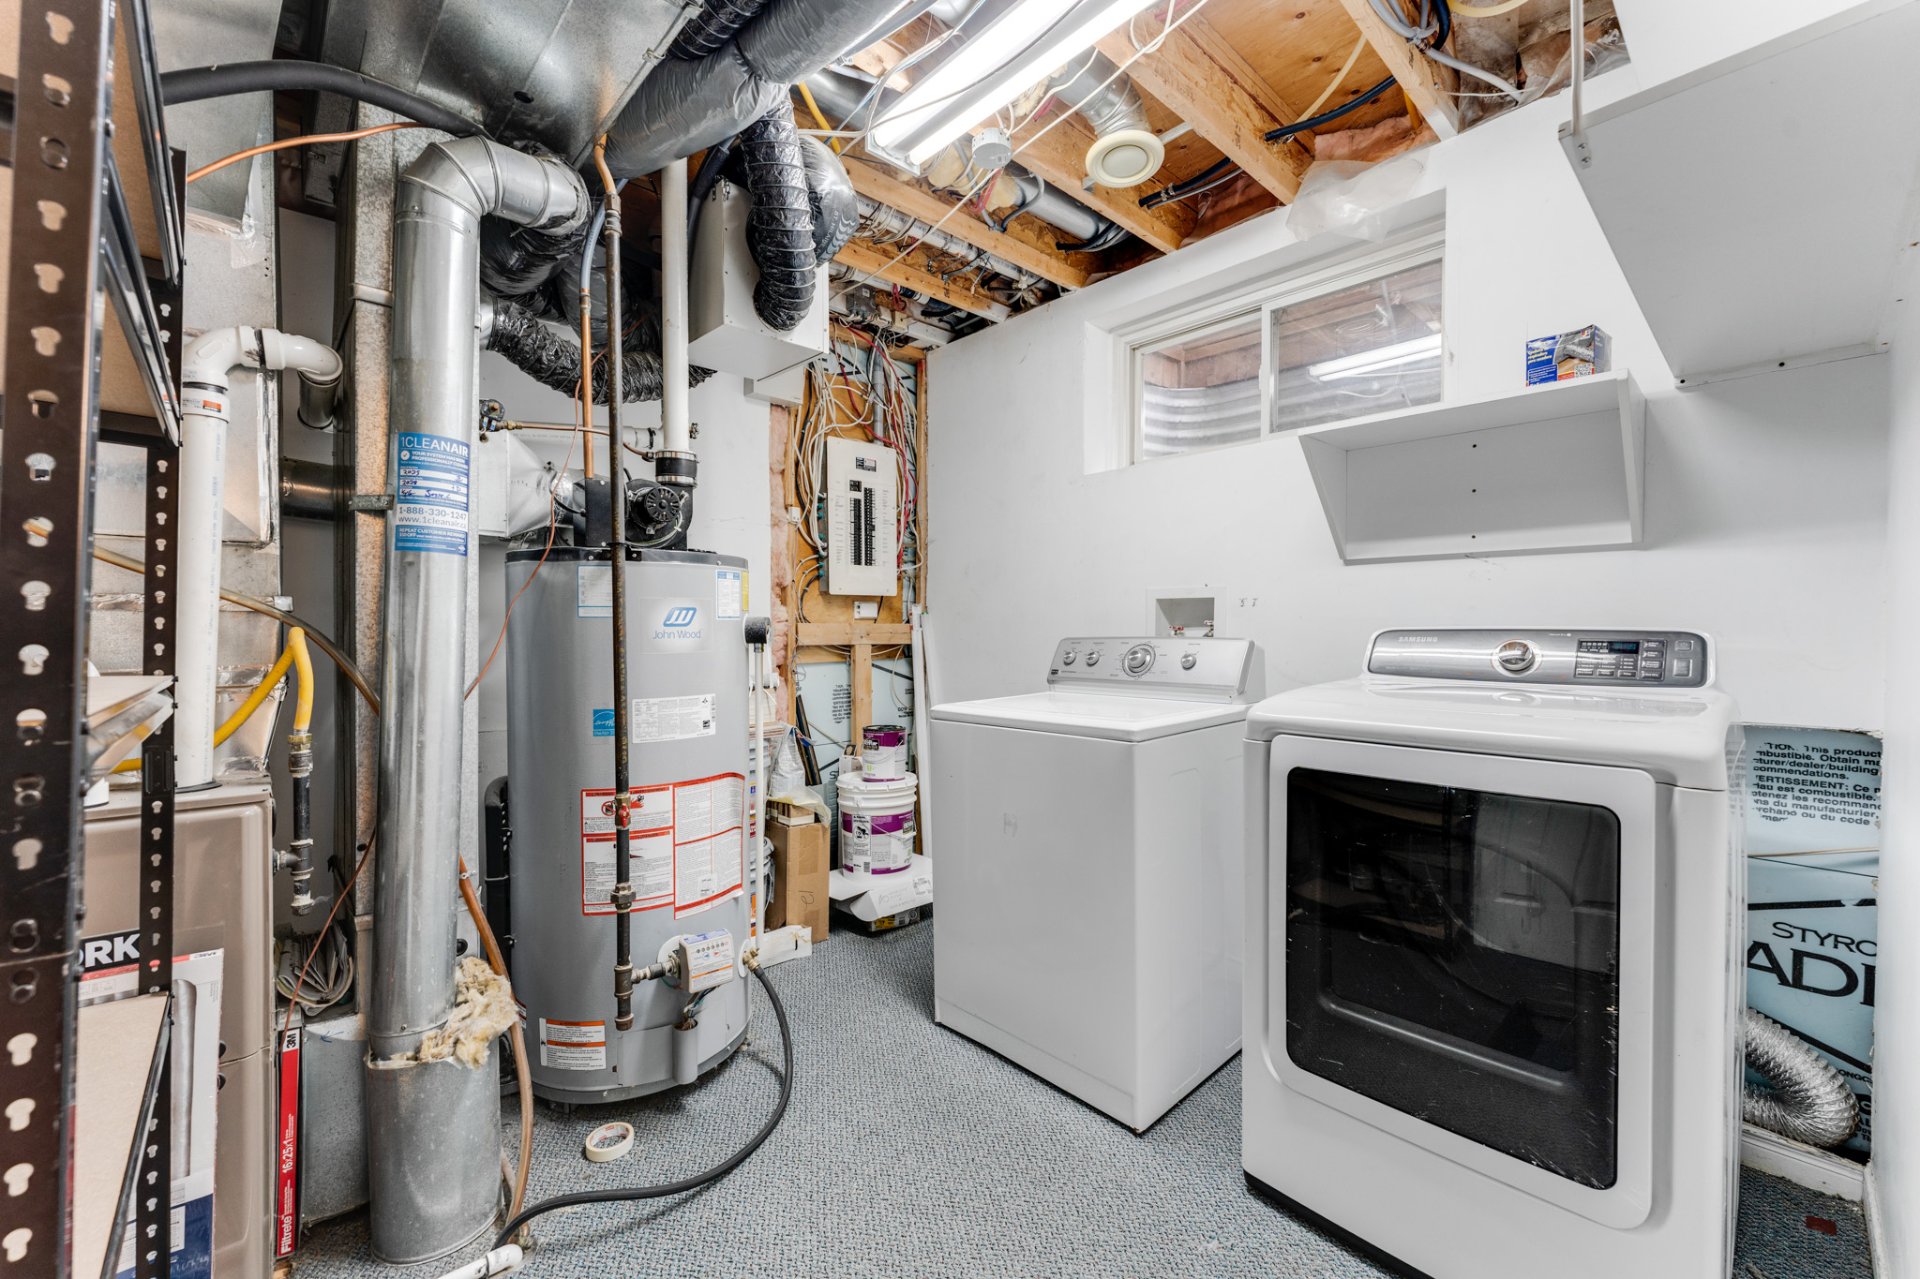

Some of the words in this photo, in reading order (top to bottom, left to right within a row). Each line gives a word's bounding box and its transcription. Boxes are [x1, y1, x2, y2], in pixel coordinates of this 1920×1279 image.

[401, 436, 469, 457] 1CLEANAIR
[399, 507, 467, 520] 1-888-330-1247
[652, 630, 675, 640] John
[677, 630, 701, 639] Wood
[1820, 754, 1860, 765] Obtain
[1777, 785, 1795, 793] est
[1798, 787, 1877, 802] combustible.
[1853, 783, 1870, 793] Ce
[1792, 793, 1809, 801] les
[1773, 799, 1788, 808] du
[1792, 802, 1879, 819] manufacturier,
[1801, 811, 1816, 819] ou
[1820, 813, 1835, 821] du
[1840, 816, 1870, 826] code
[286, 1033, 298, 1049] 3M
[282, 1138, 294, 1174] 16x25x1
[280, 1215, 293, 1254] Filtrete
